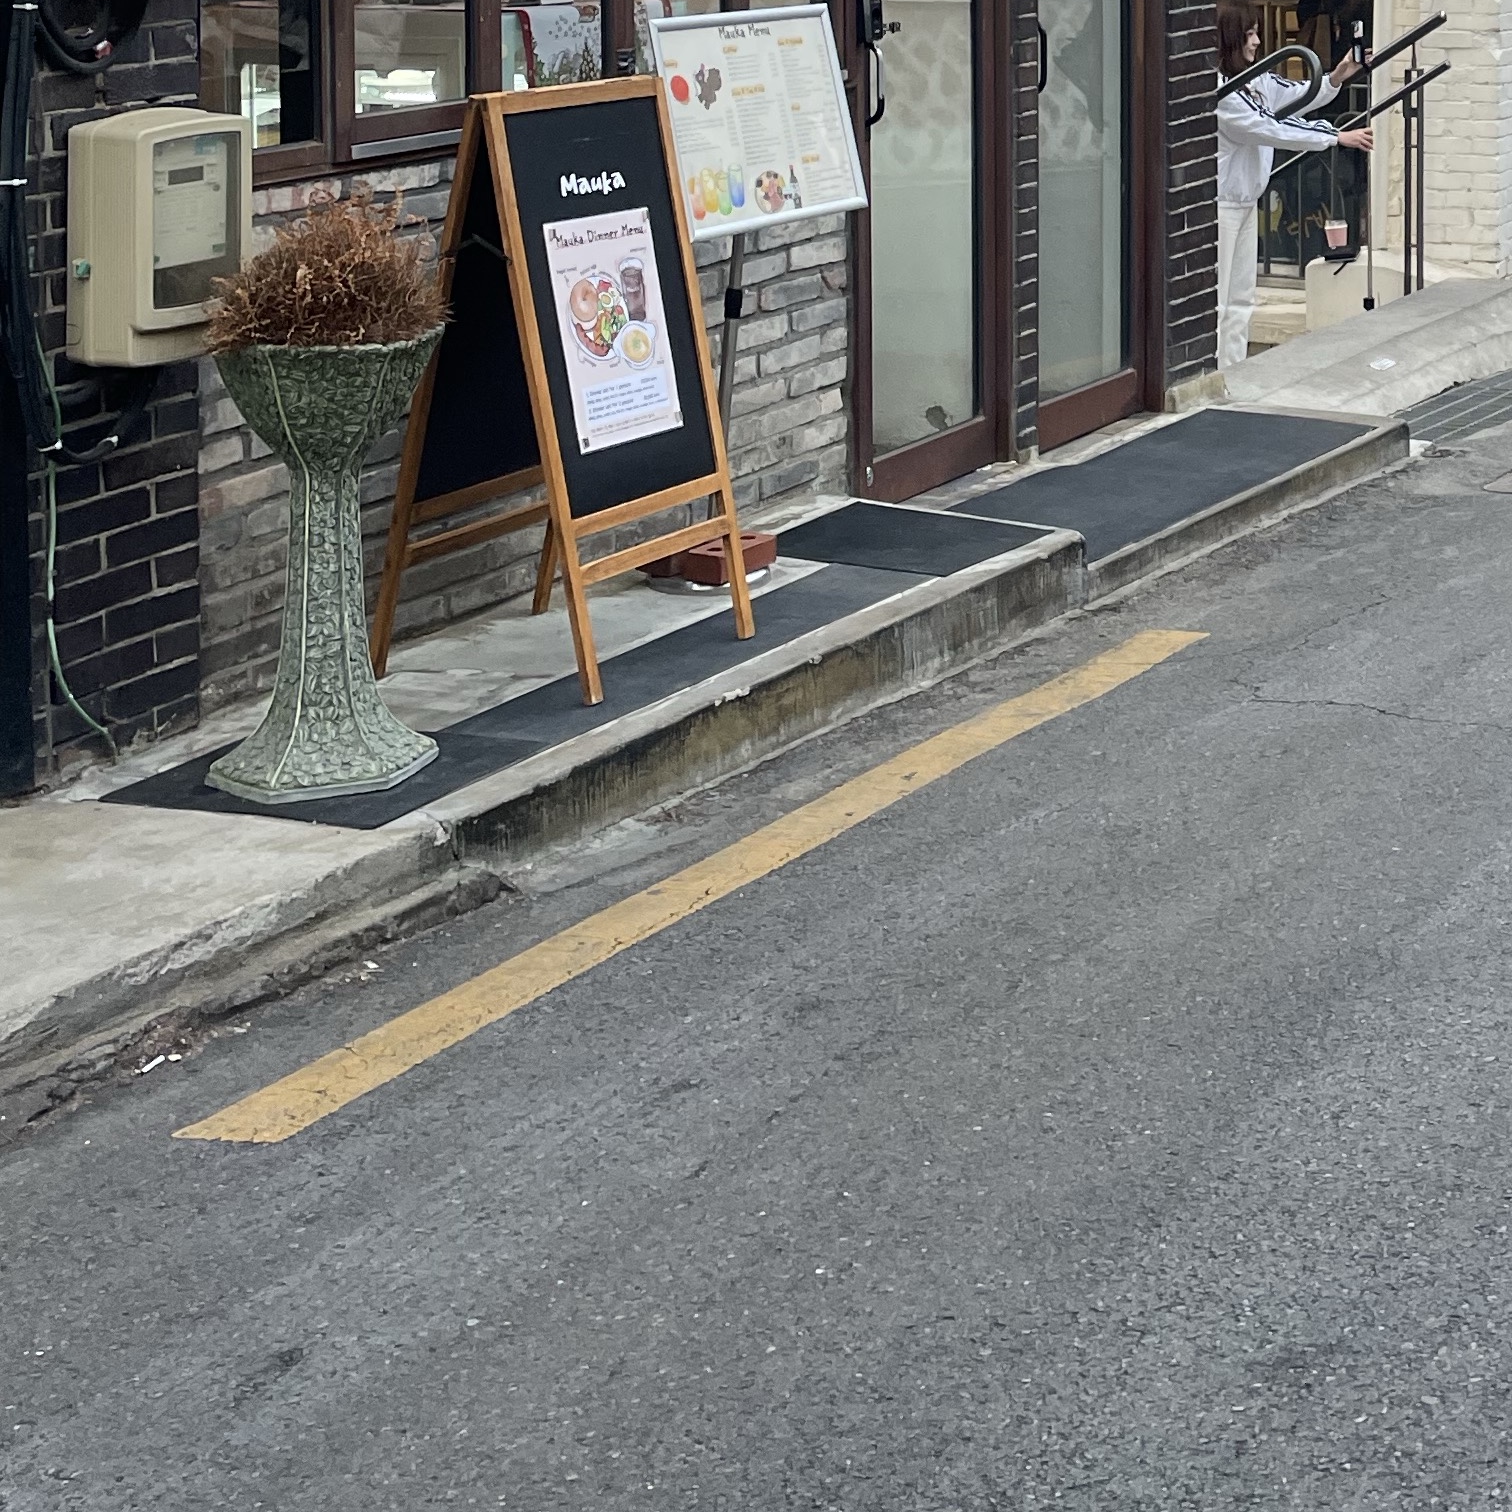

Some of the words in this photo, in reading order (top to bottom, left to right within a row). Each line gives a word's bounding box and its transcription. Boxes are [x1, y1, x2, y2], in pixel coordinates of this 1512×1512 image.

[717, 24, 746, 39] Mauka
[747, 22, 771, 36] Menu
[560, 171, 626, 197] Mauka
[556, 231, 584, 248] Mauka
[621, 224, 645, 238] Menu
